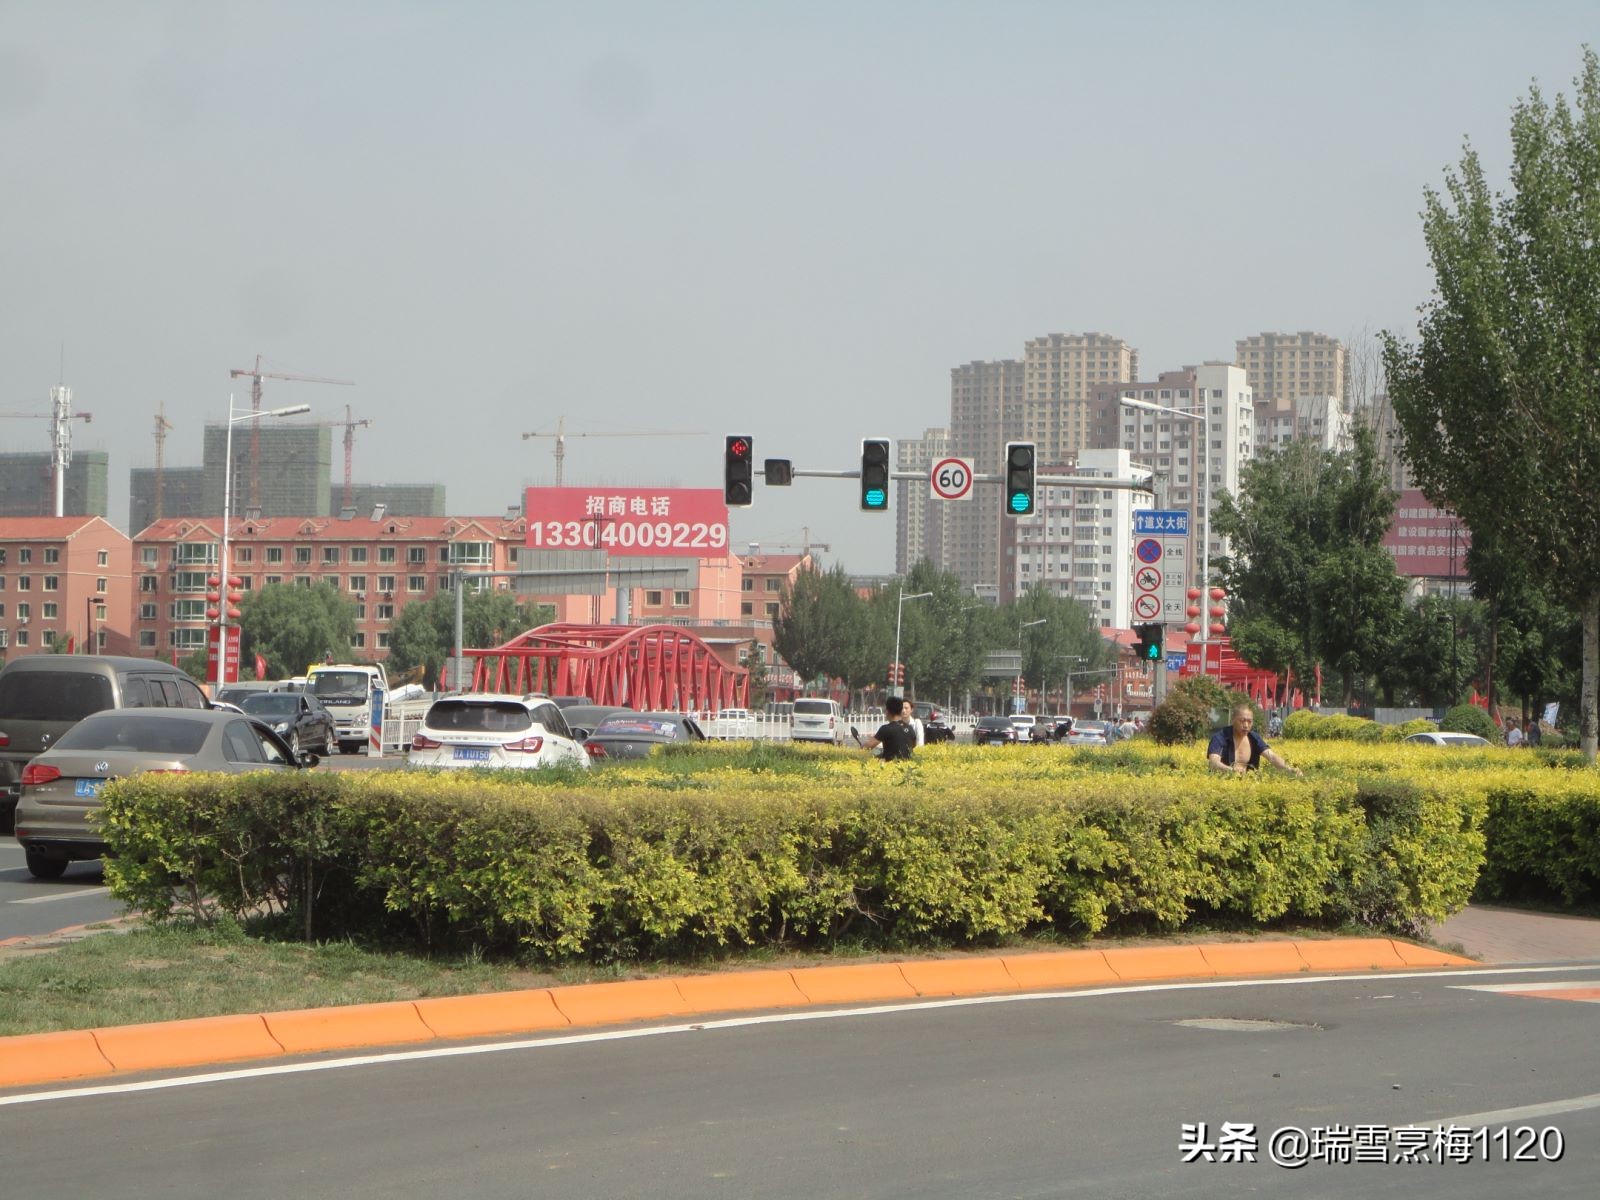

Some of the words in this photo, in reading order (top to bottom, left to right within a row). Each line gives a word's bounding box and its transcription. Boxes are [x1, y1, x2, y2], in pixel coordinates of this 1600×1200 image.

[939, 470, 964, 488] 60
[585, 495, 671, 516] 招商电话
[1144, 515, 1187, 530] 道义大街
[530, 521, 727, 548] 13304009229
[1165, 603, 1182, 611] 全天
